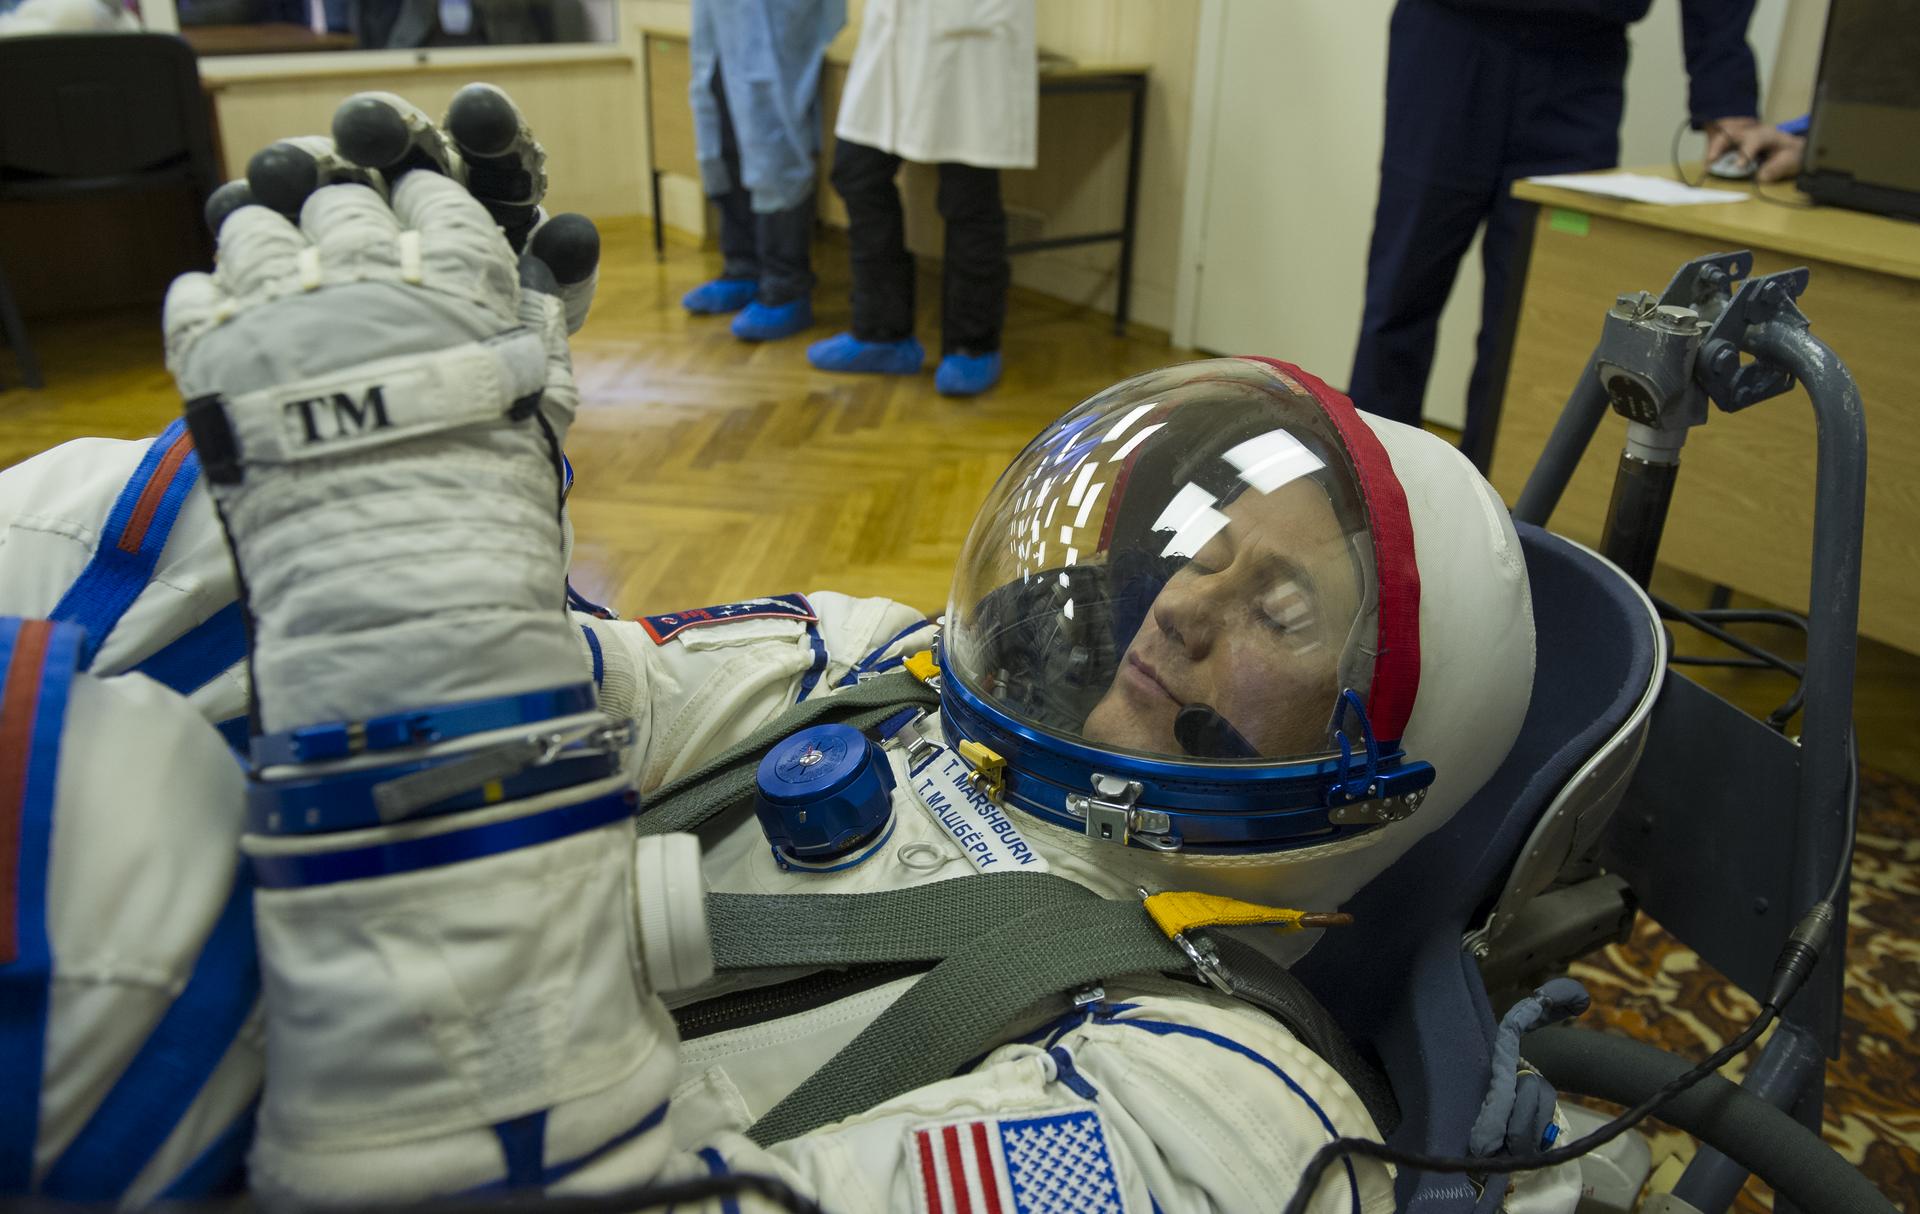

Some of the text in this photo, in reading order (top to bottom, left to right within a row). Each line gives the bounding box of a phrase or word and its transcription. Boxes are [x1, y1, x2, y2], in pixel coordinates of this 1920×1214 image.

[284, 385, 394, 442] TM
[918, 779, 997, 867] Т. МАШБЁРН
[943, 759, 1036, 865] T. MARSHBURN
